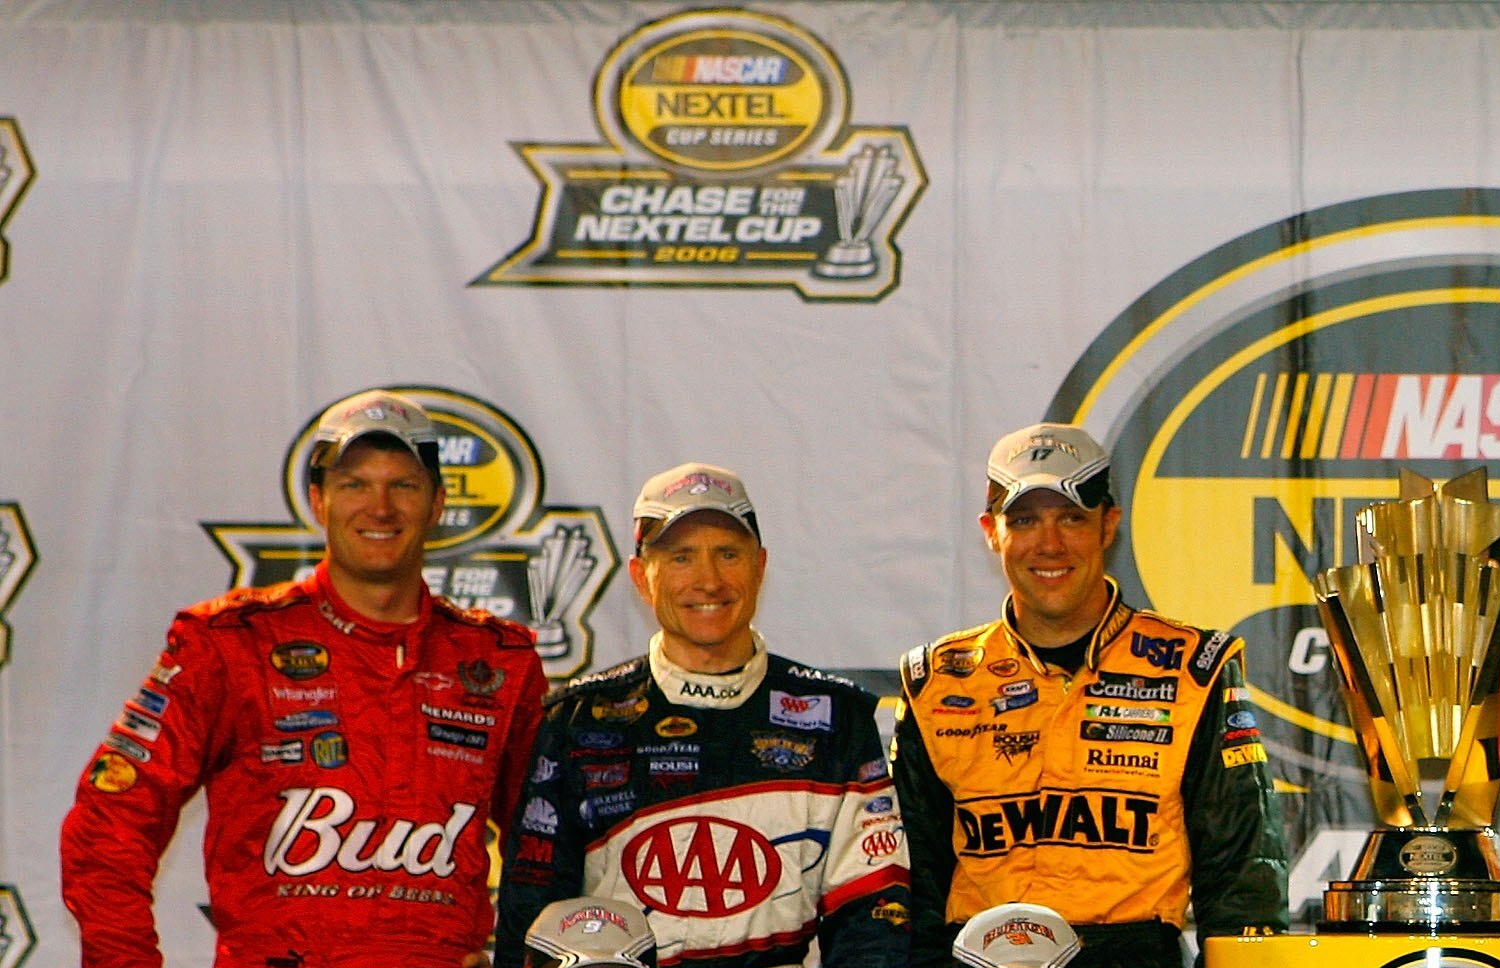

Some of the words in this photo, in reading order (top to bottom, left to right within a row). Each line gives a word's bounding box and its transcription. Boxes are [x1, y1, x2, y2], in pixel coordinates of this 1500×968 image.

[695, 57, 786, 83] NASCAR
[656, 93, 783, 118] NEXTEL
[666, 126, 704, 146] CUP
[709, 126, 777, 147] SERIES
[601, 187, 753, 215] CHASE
[760, 188, 806, 202] FOR
[759, 202, 801, 216] THE
[575, 216, 732, 243] NEXTEL
[736, 218, 822, 243] CUP
[652, 247, 741, 263] 2006
[1131, 631, 1186, 670] USG
[1088, 681, 1175, 701] Carhartt
[420, 703, 496, 727] MENARDS
[935, 723, 1009, 739] GOODYEAR
[993, 734, 1040, 746] ROUSH
[1105, 725, 1153, 741] Silicone
[650, 761, 699, 772] ROUSH
[1087, 749, 1160, 771] Rinnai
[263, 786, 477, 877] Bud
[956, 794, 1158, 850] DEWALT
[862, 830, 898, 857] AAA
[635, 818, 770, 916] AAA
[276, 884, 340, 898] KING
[346, 884, 382, 899] OF
[388, 885, 456, 905] BEERS
